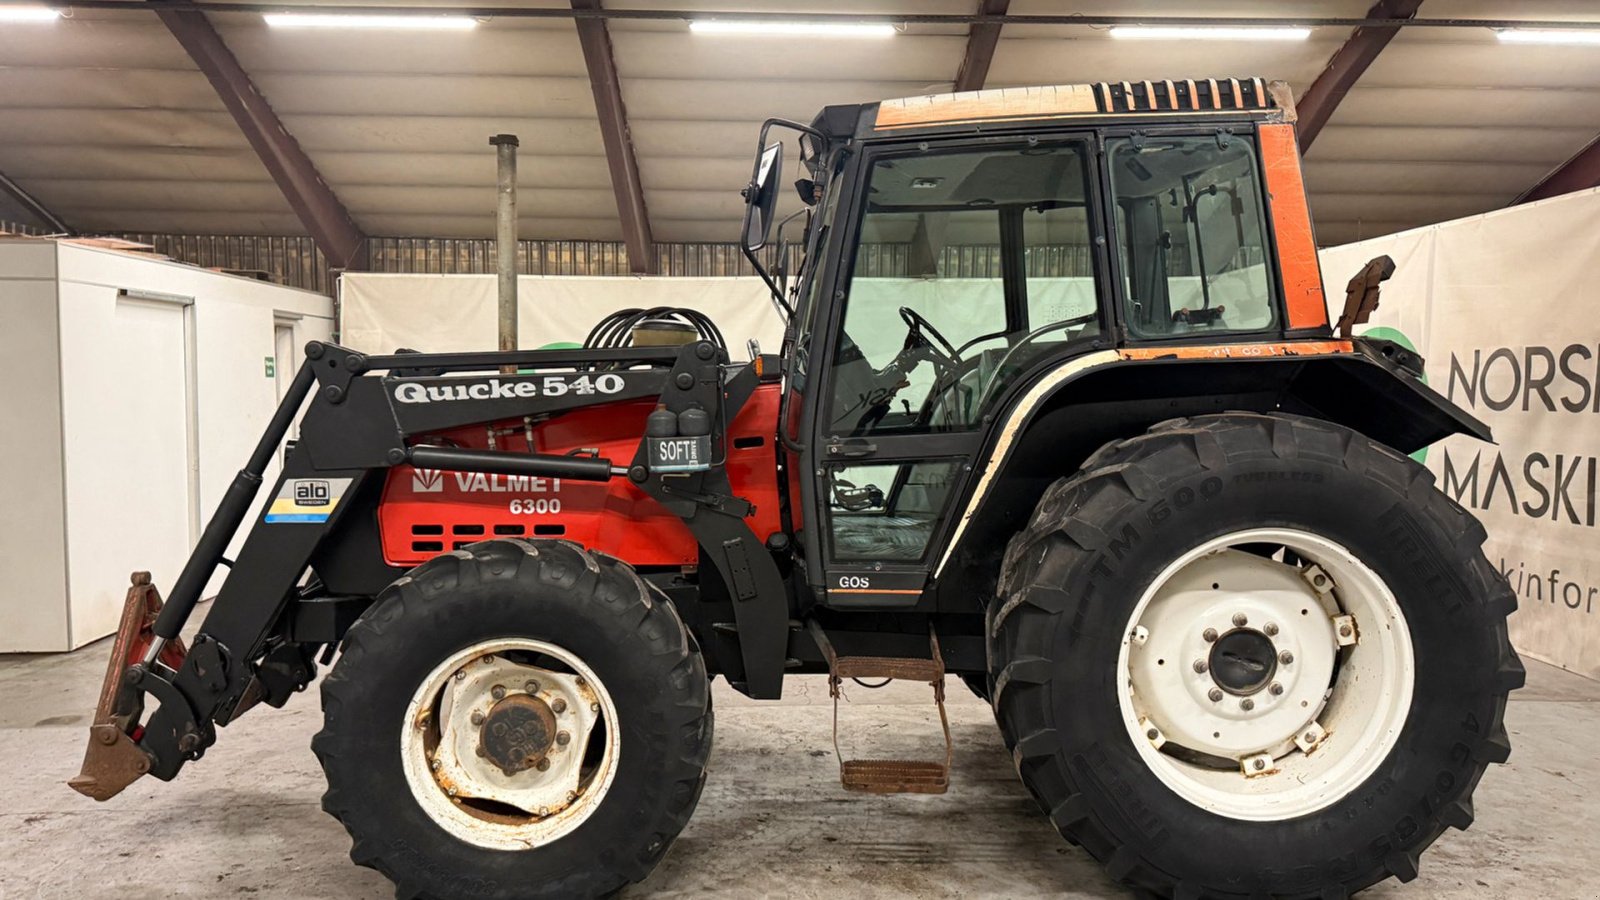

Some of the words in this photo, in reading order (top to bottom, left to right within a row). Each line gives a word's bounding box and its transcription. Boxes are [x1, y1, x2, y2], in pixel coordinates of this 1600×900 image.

[1447, 343, 1600, 413] NORS
[394, 378, 536, 404] Quicke
[543, 374, 625, 397] 540
[659, 440, 690, 461] SOFT
[297, 483, 326, 498] alo
[509, 498, 561, 515] 6300
[1088, 522, 1141, 580] TM
[839, 576, 870, 589] GOS
